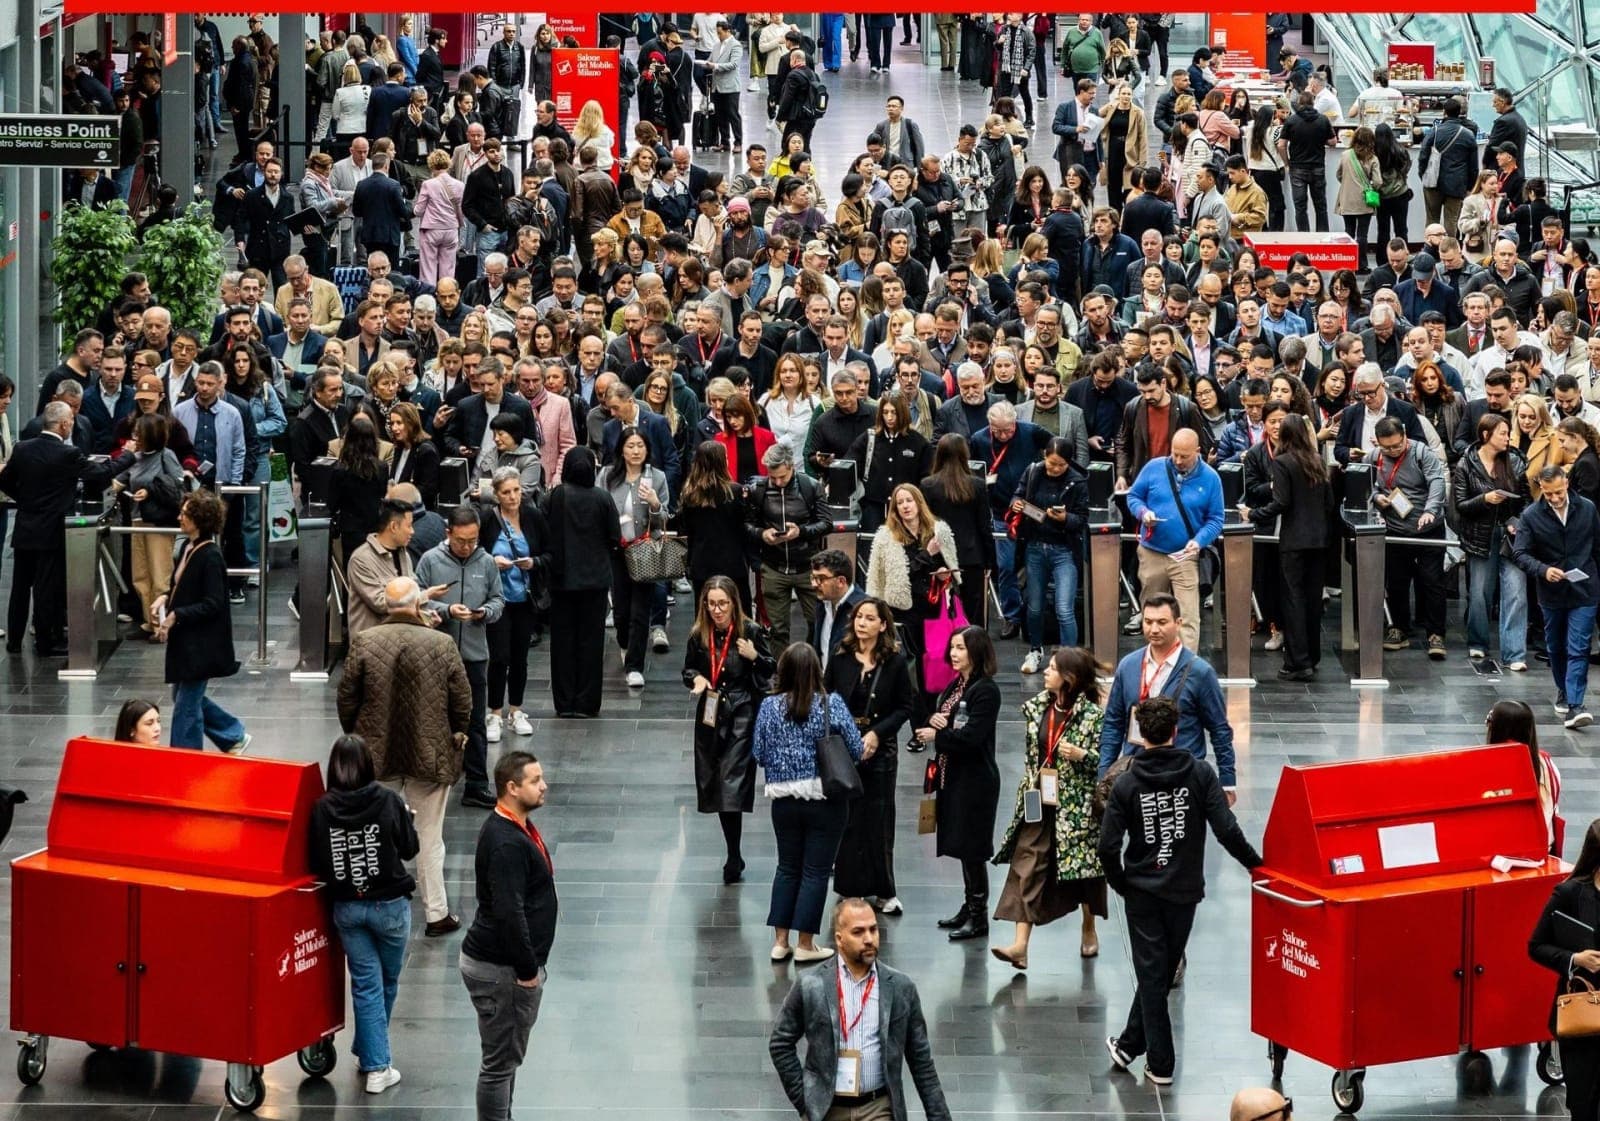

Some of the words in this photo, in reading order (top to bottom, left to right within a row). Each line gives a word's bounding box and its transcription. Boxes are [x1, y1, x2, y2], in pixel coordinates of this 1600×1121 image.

[577, 53, 600, 62] Salone
[577, 61, 588, 70] del
[577, 69, 601, 77] Milano
[67, 123, 111, 138] Point
[15, 139, 43, 148] Servizi
[50, 140, 82, 149] Service
[83, 141, 112, 149] Centre
[1156, 791, 1173, 814] del
[1140, 792, 1157, 845] Milano
[1172, 787, 1189, 839] Salone
[329, 826, 347, 881] Milano
[363, 824, 381, 876] Salone
[294, 928, 317, 946] Salone
[1282, 928, 1308, 950] Salone
[294, 943, 305, 960] del
[1282, 943, 1294, 959] del
[294, 956, 318, 975] Milano
[1282, 956, 1307, 978] Milano
